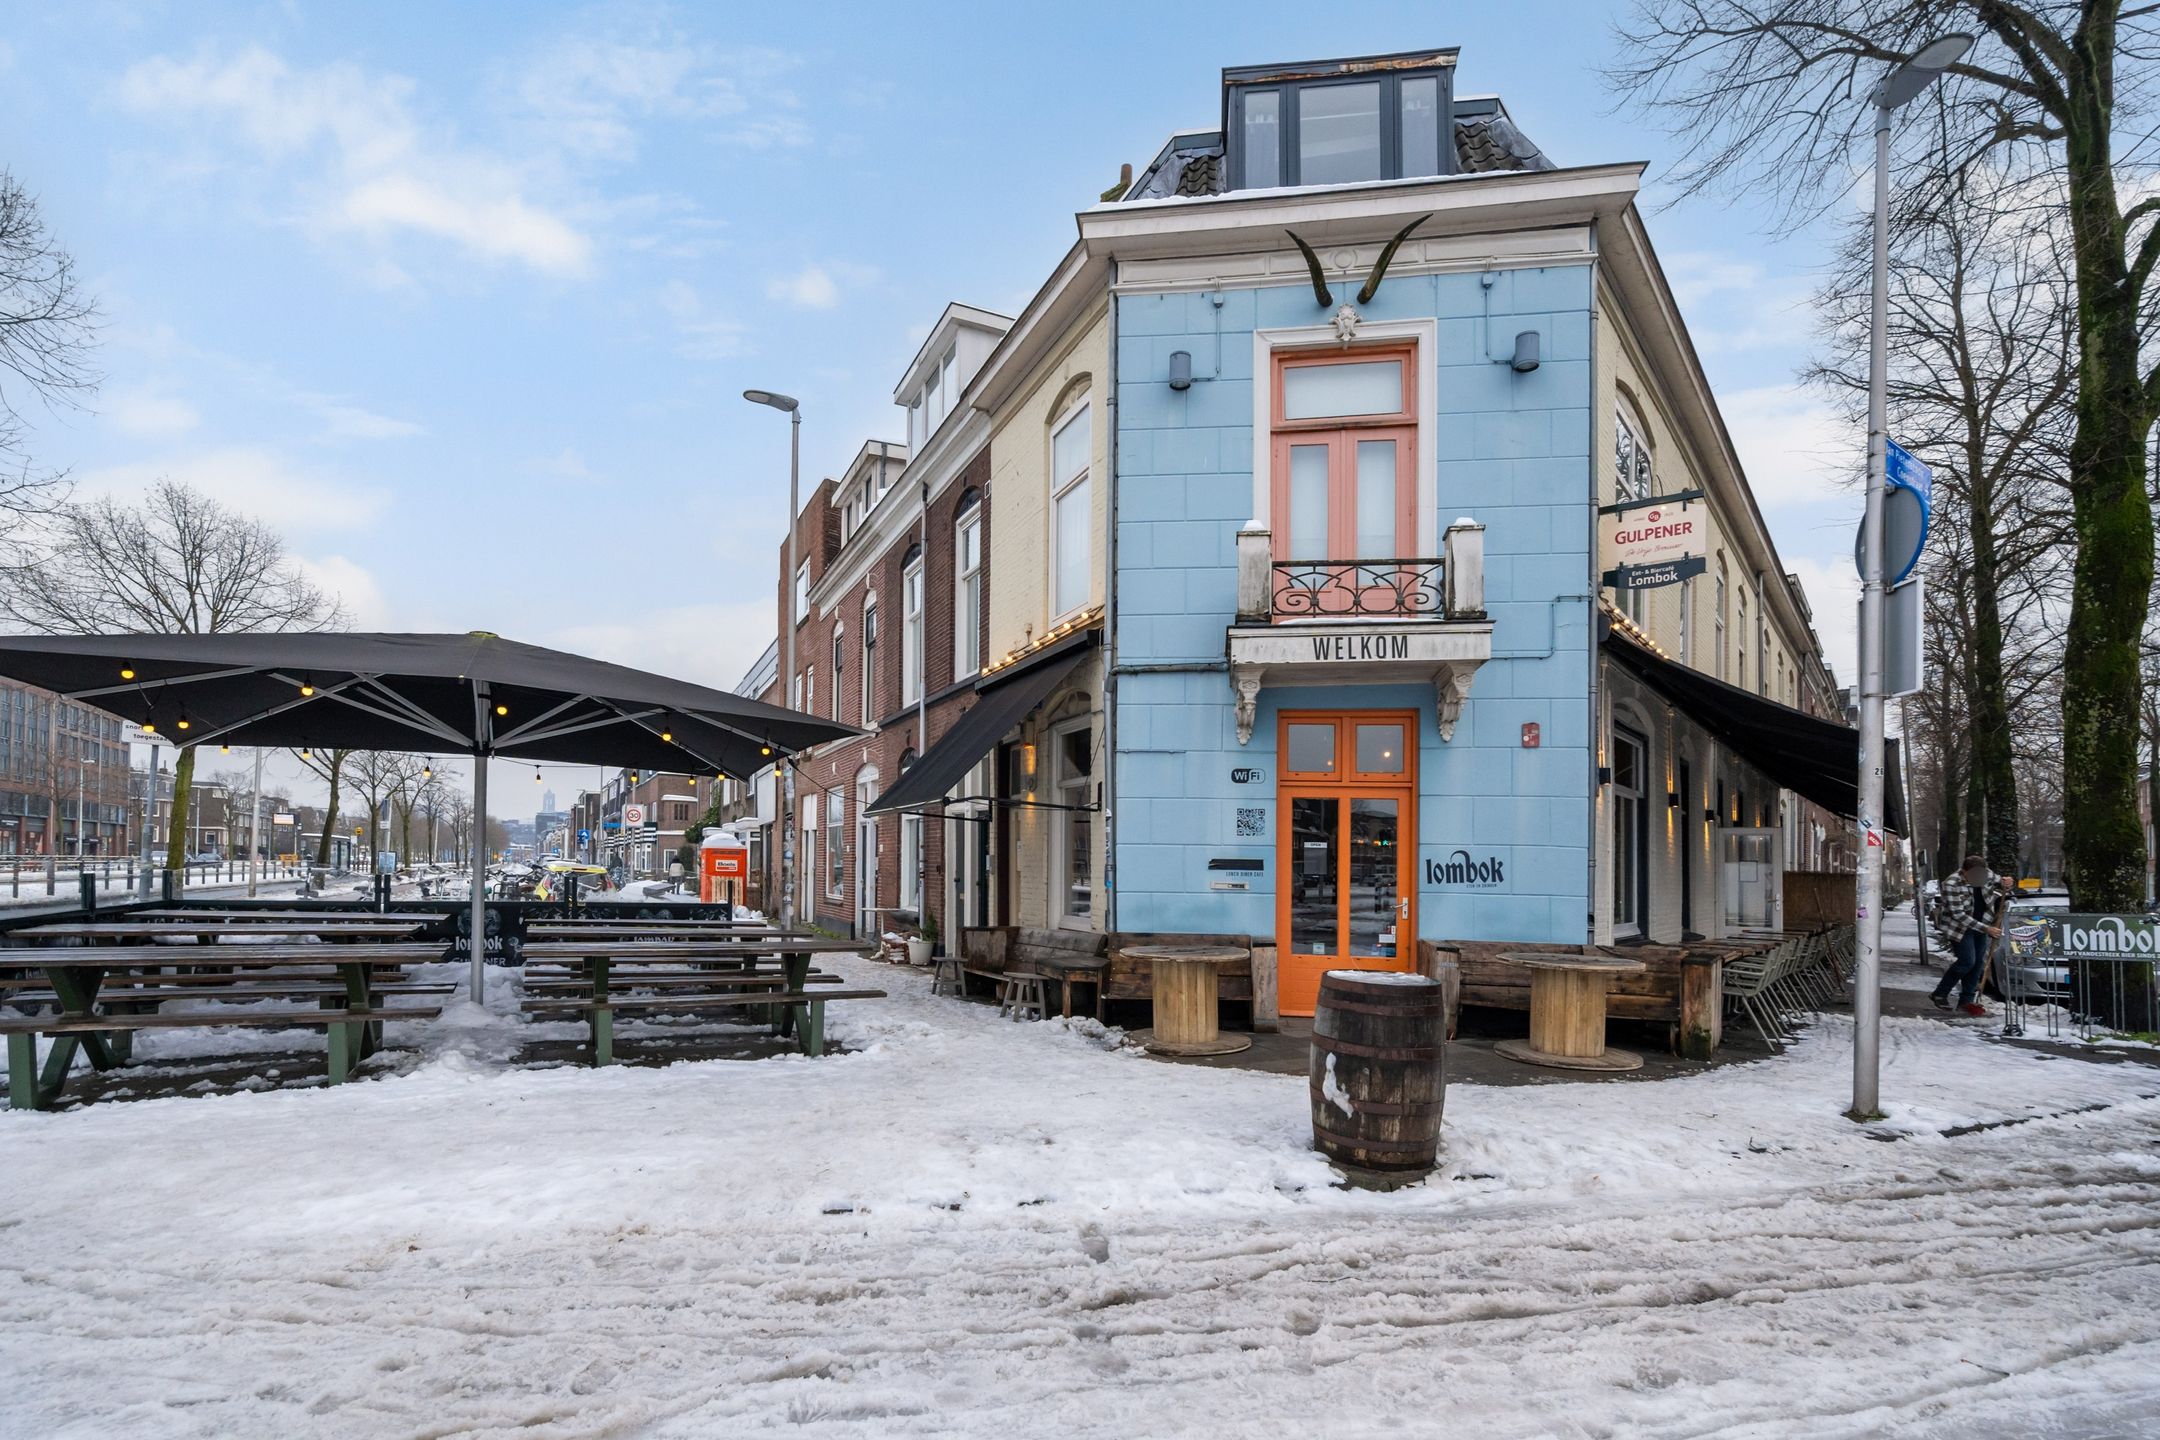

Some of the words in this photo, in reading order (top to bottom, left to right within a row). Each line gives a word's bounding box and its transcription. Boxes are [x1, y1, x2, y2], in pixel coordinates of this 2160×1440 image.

[1615, 521, 1692, 544] GULPENER
[1628, 571, 1678, 587] Lombok
[1312, 635, 1408, 660] WELKOM
[1425, 850, 1504, 884] lombok
